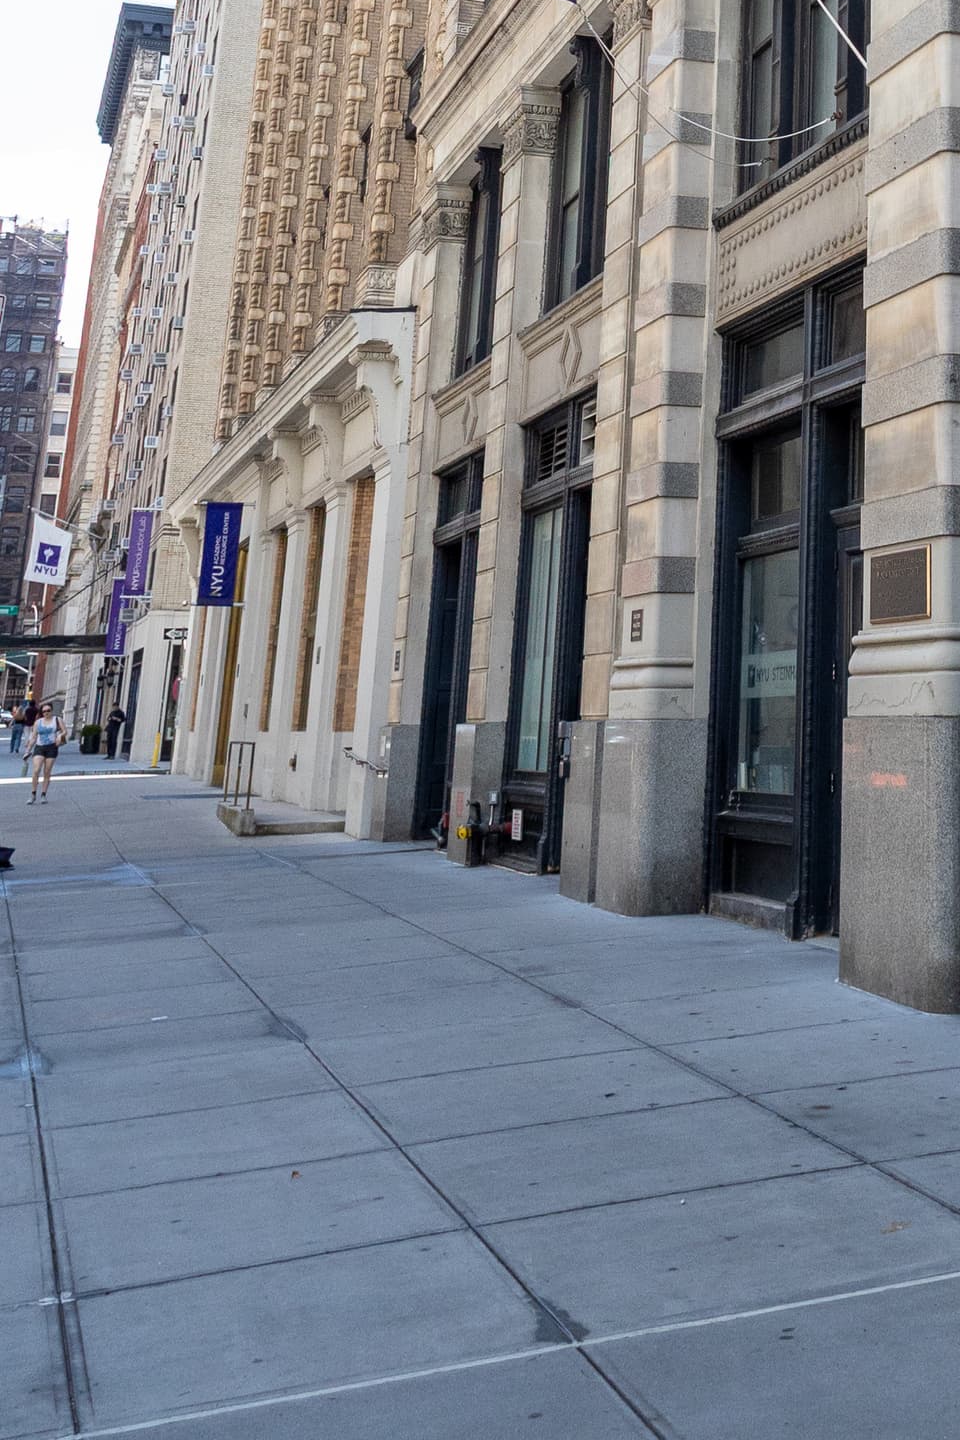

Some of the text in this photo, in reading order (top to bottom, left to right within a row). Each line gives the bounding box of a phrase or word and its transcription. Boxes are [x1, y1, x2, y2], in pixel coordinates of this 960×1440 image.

[213, 535, 222, 565] ACADEMIC
[220, 511, 230, 566] RESOURCE CENTER
[33, 565, 58, 577] NYU
[209, 565, 225, 597] NYU
